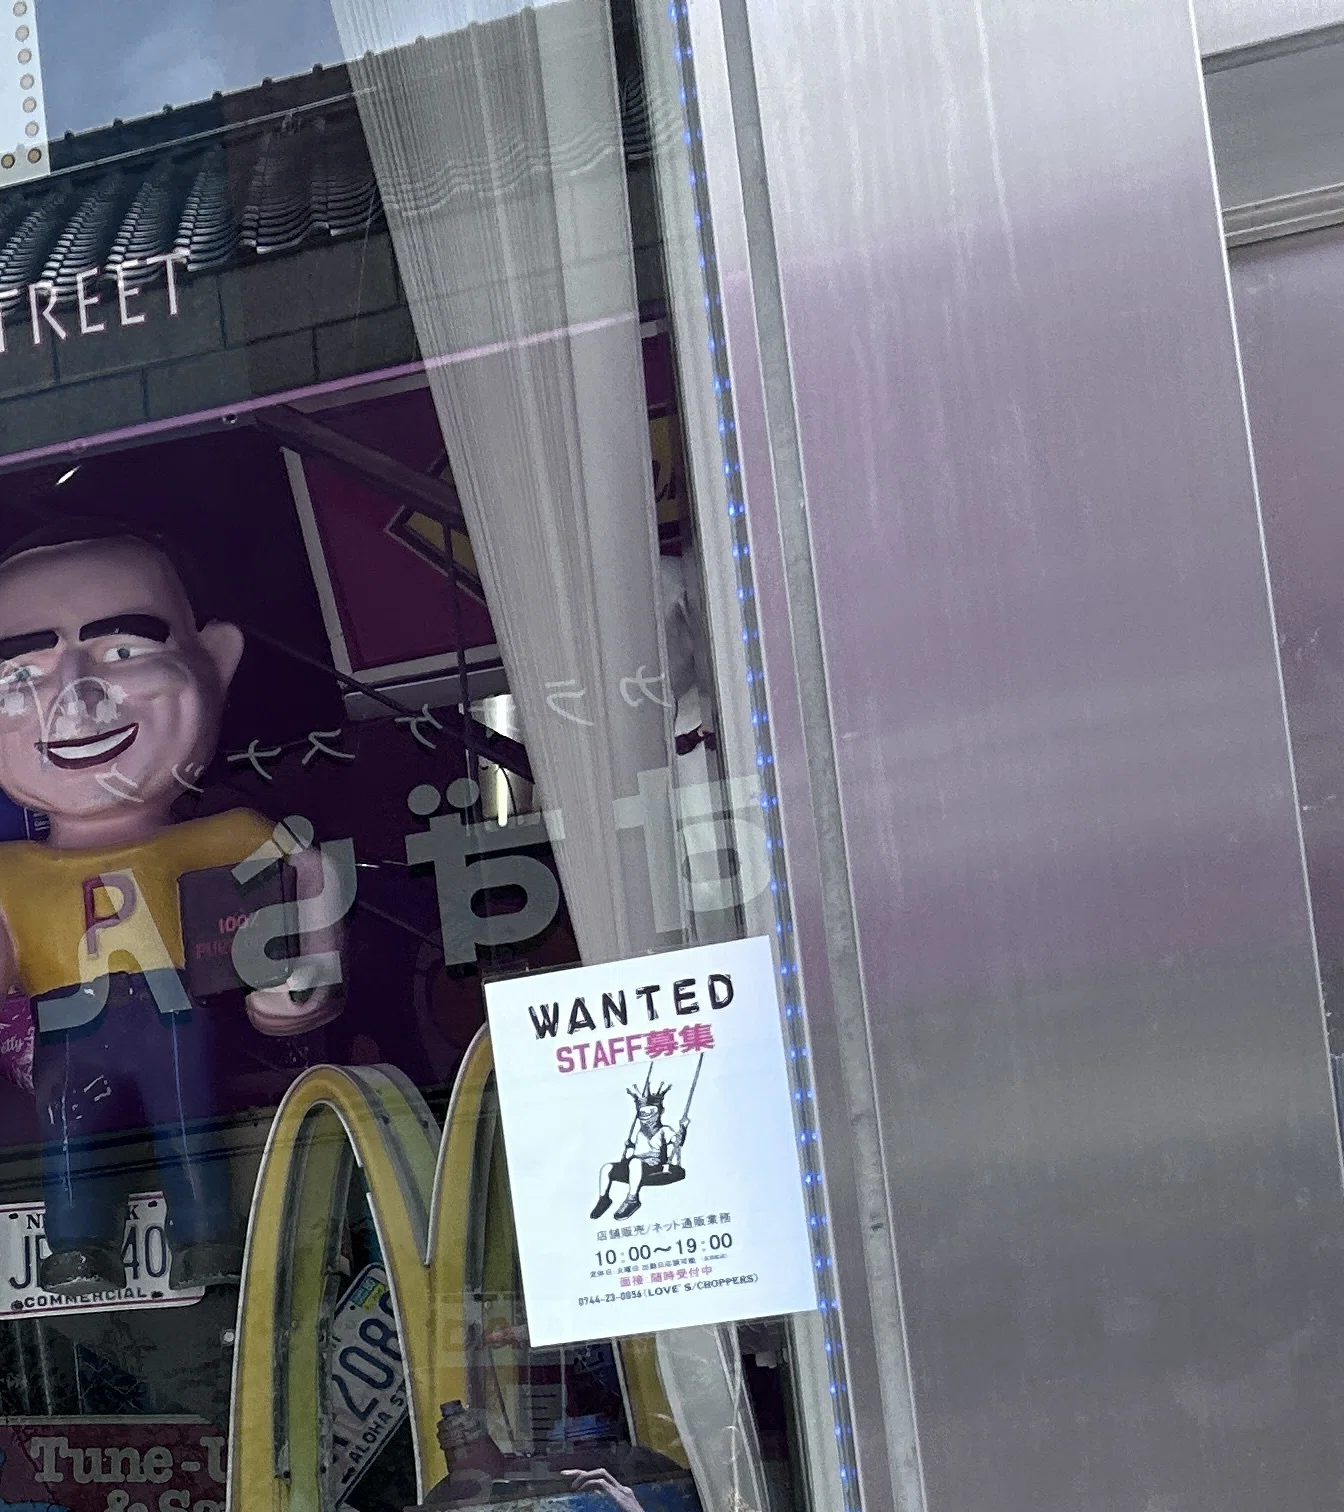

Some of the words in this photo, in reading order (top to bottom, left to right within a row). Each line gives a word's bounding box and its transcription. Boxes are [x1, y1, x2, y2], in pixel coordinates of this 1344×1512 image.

[82, 872, 137, 959] P
[528, 973, 734, 1040] WANTED
[555, 1023, 715, 1074] STAFF募集
[24, 1287, 148, 1309] COMMERCIAL
[349, 1411, 392, 1464] ALOHA
